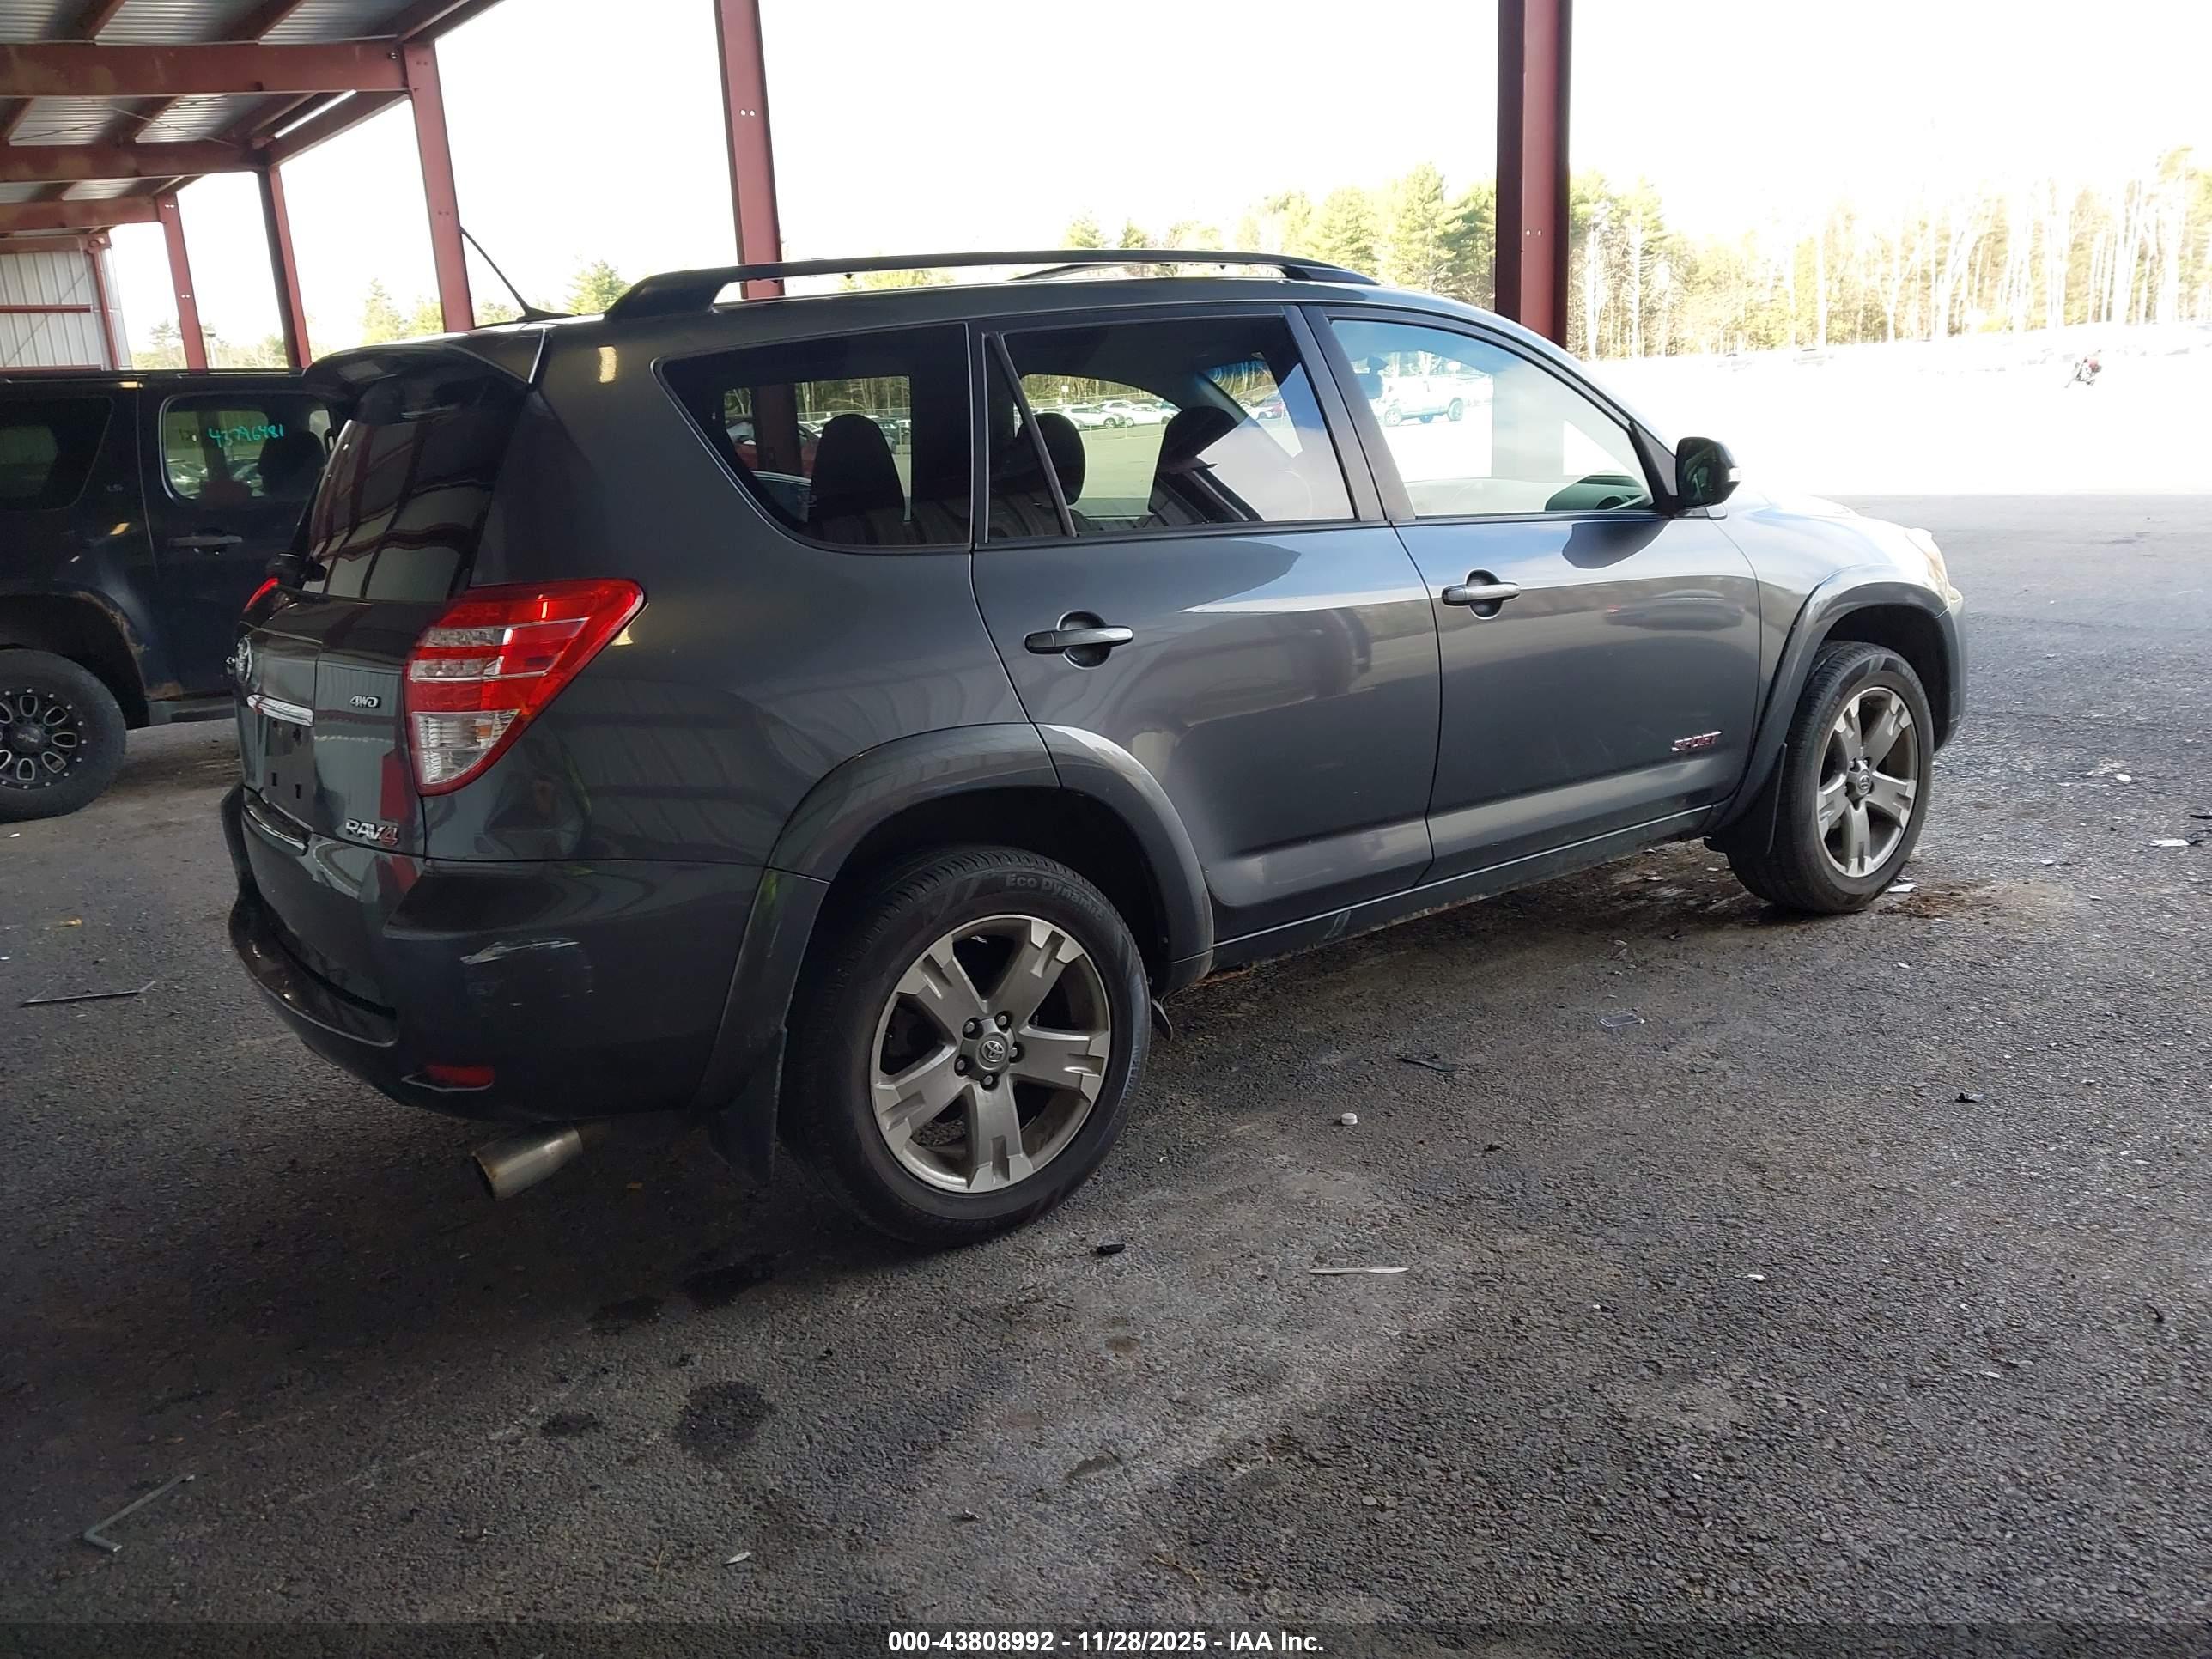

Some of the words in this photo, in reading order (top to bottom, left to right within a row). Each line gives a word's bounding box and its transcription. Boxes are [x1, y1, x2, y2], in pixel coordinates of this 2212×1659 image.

[349, 695, 379, 708] 4WD
[1671, 731, 1723, 752] SPORT
[345, 819, 398, 846] RAV4
[1005, 875, 1038, 888] Eco
[1040, 877, 1104, 921] Dynamic
